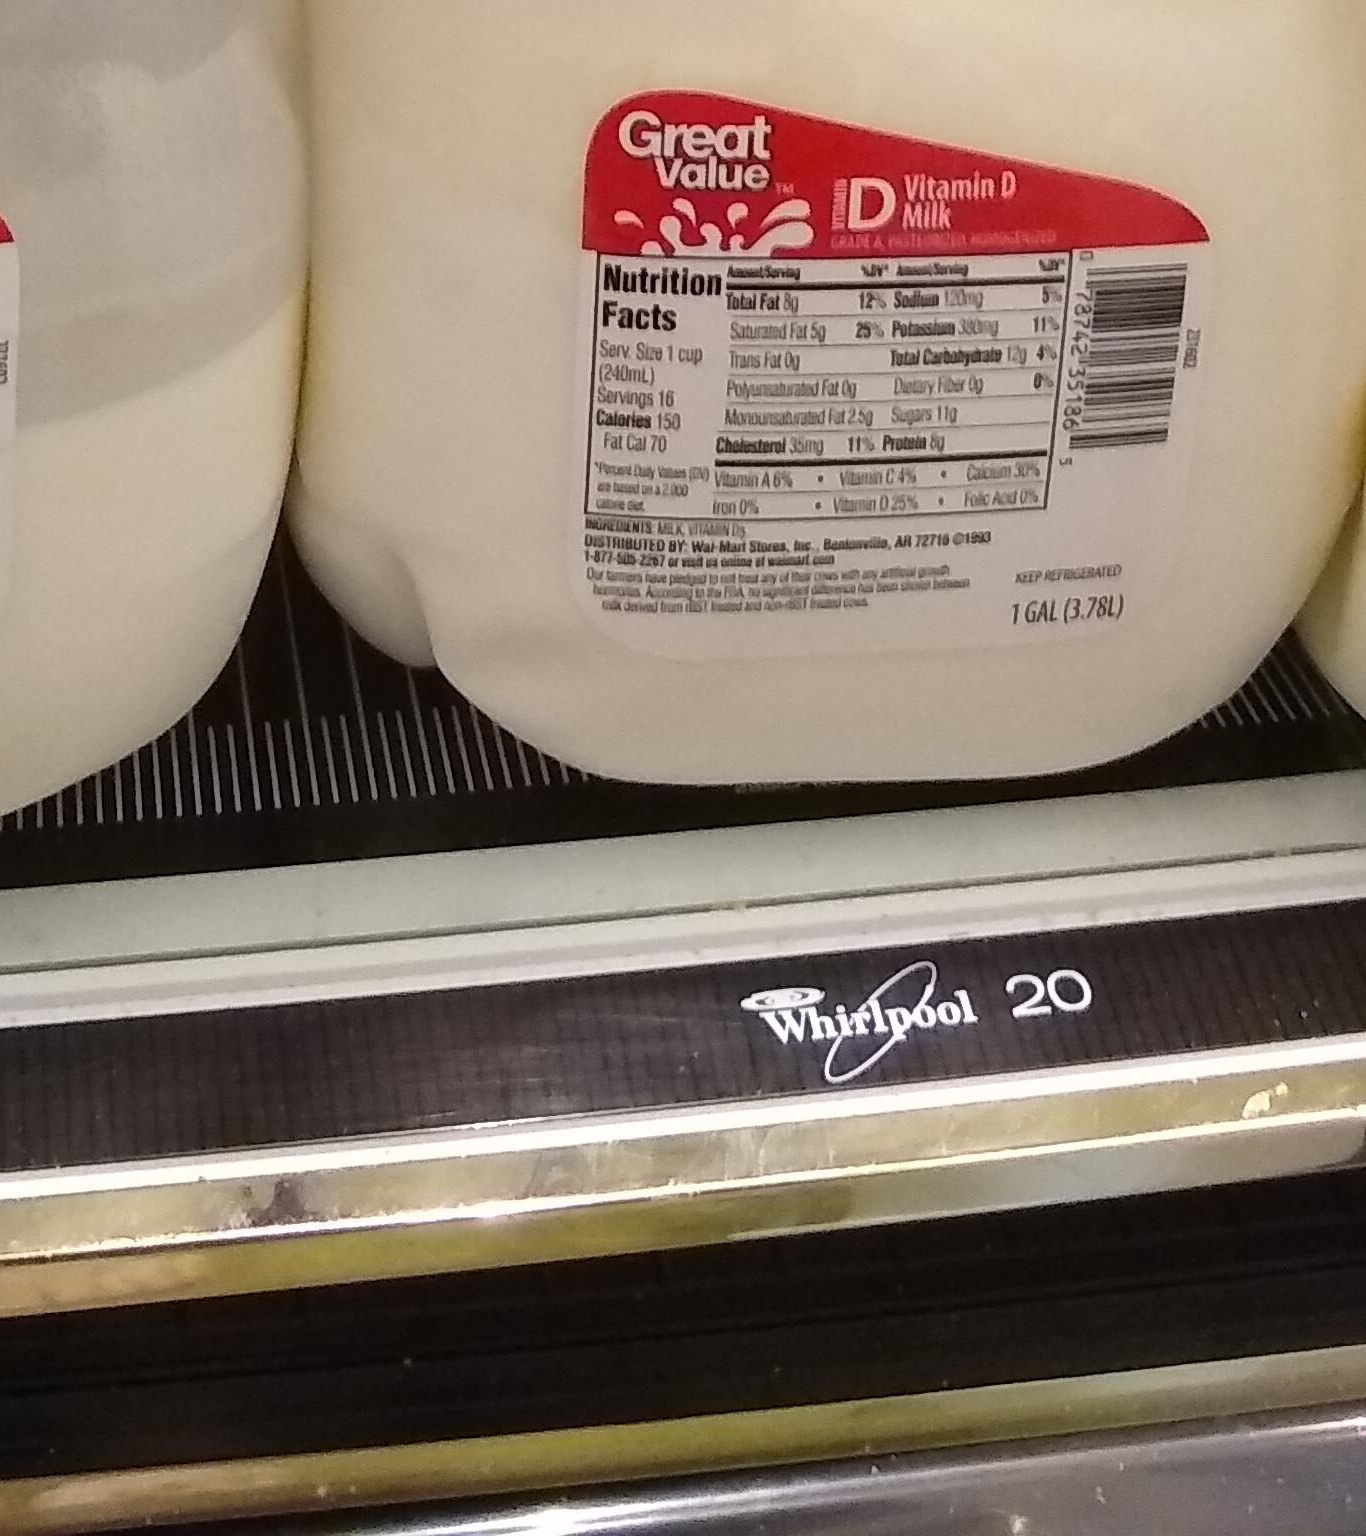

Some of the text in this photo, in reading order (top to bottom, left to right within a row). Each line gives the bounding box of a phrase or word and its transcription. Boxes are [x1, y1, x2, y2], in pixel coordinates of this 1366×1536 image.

[618, 110, 772, 162] Great
[654, 156, 771, 191] Value
[903, 169, 1017, 202] Vitamin D
[847, 177, 897, 233] D
[902, 200, 952, 231] Milk
[603, 264, 722, 296] Nutrition
[602, 300, 677, 331] Facts
[599, 363, 655, 385] (240mL)
[597, 387, 675, 409] Servings 16
[596, 410, 681, 430] Calories 150
[603, 433, 667, 452] Fat Cal 70
[716, 437, 786, 454] Cholesterol
[883, 434, 927, 451] Protein
[1011, 594, 1124, 624] 1 GAL (3.78L)
[759, 968, 1093, 1045] Whirlpool 20
